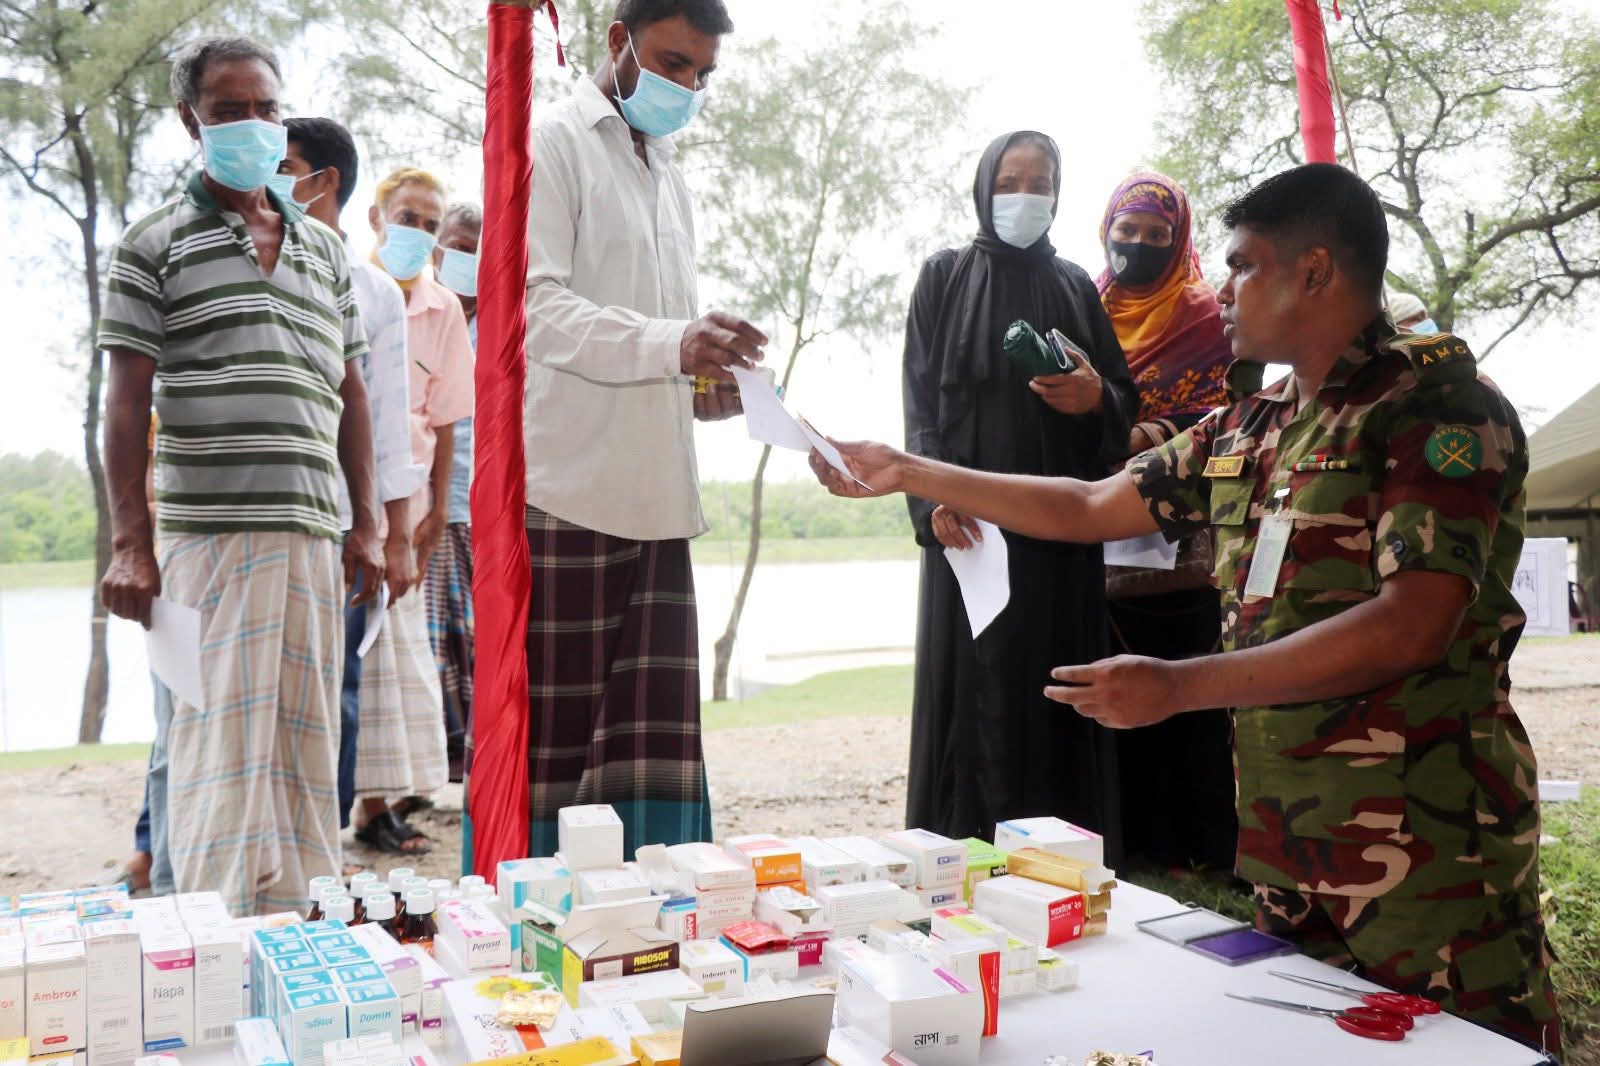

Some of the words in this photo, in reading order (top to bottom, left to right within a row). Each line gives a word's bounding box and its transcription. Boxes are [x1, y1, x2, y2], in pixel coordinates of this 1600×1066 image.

[1422, 345, 1466, 365] AMC
[33, 989, 79, 1001] Ambrox
[153, 984, 185, 1000] Napa
[360, 1010, 392, 1024] Domin
[914, 1031, 939, 1048] নাপা
